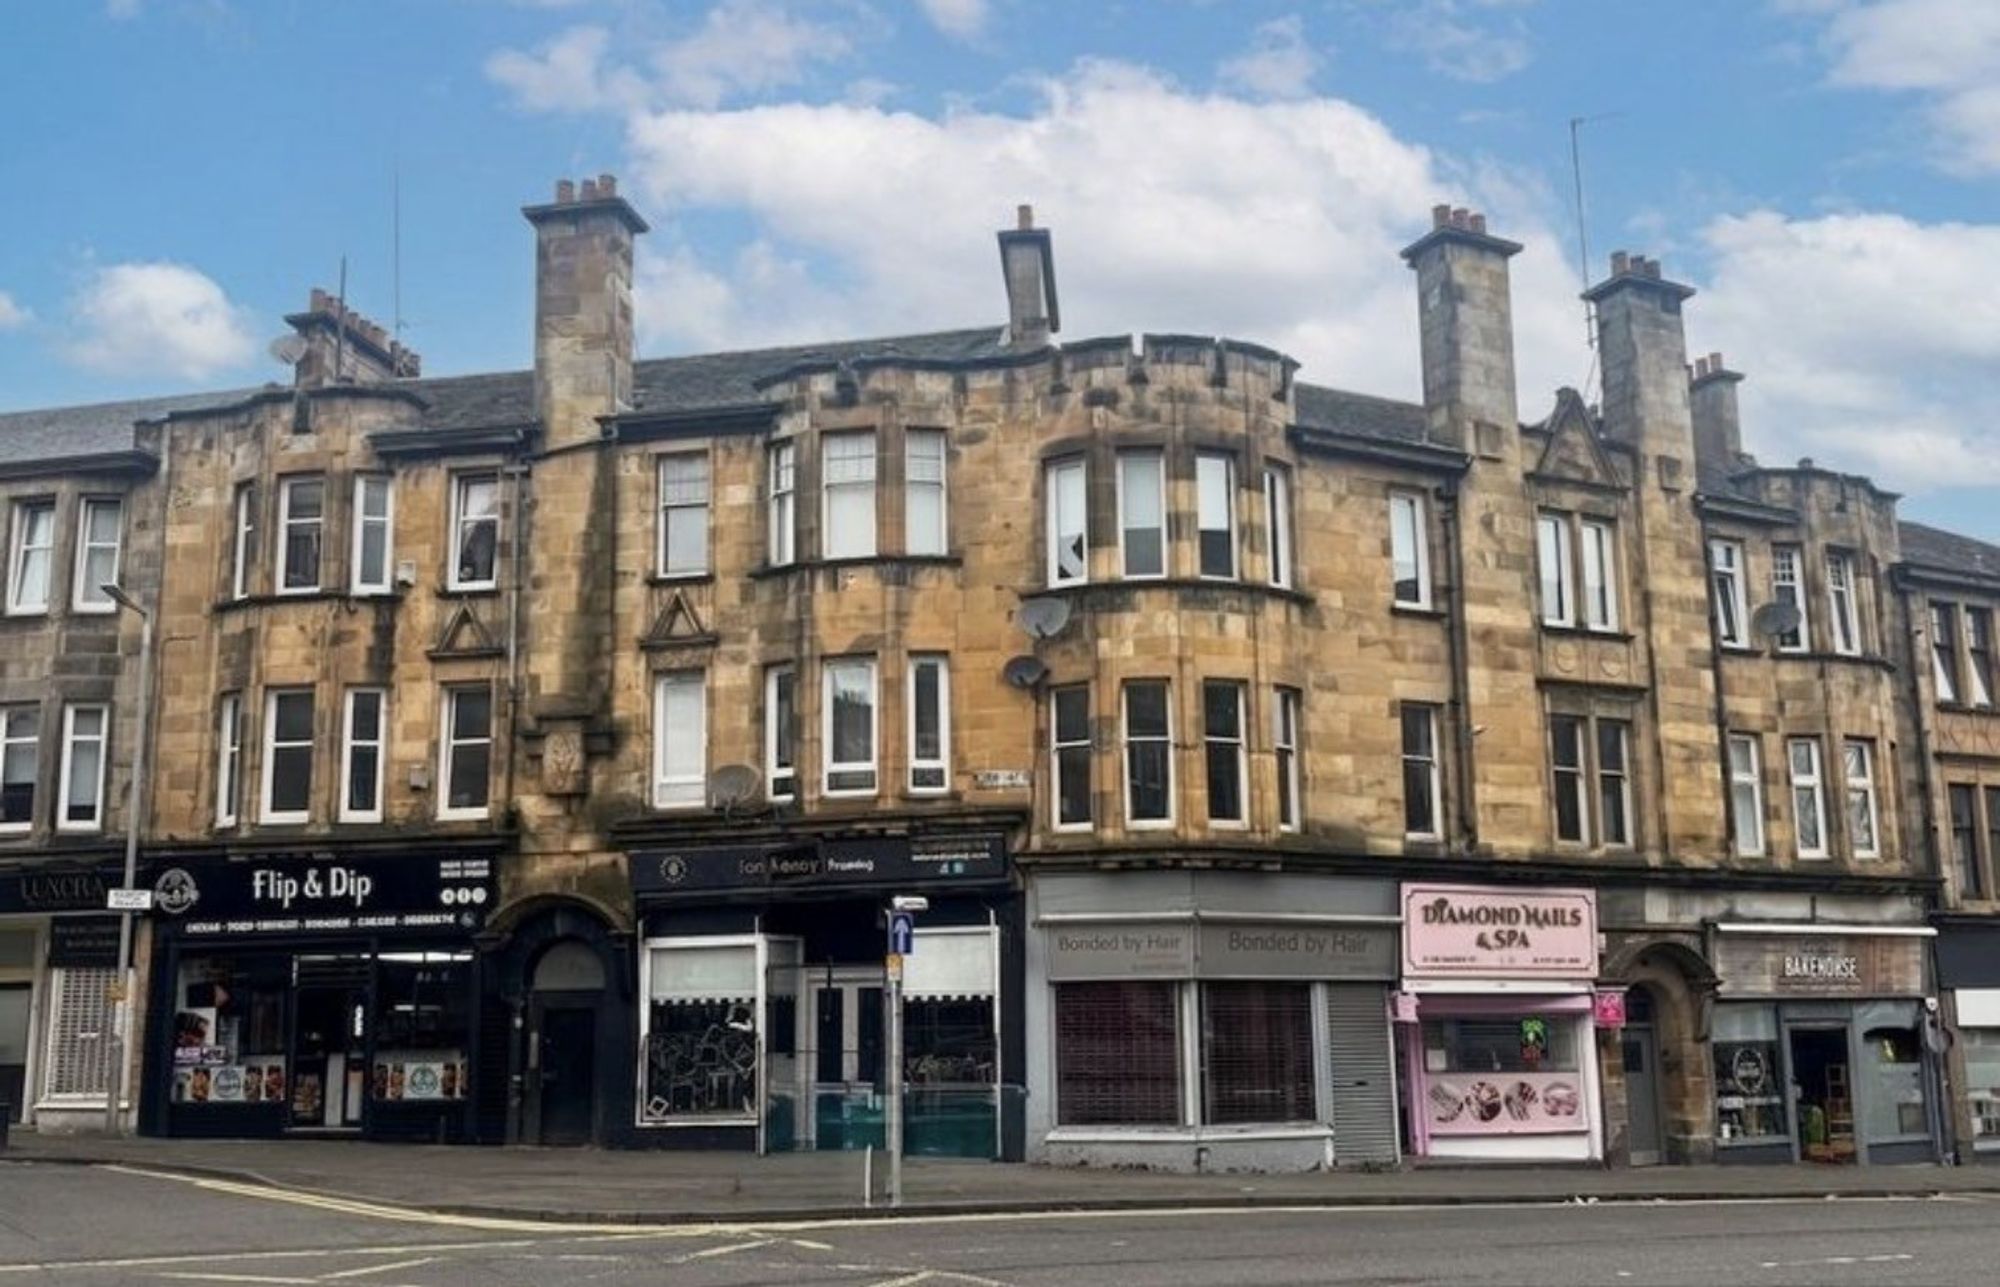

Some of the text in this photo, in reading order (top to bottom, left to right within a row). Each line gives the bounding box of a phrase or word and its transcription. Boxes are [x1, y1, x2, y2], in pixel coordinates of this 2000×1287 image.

[253, 866, 373, 909] Flip & Dip
[1421, 899, 1582, 929] DIAMOND NAILS
[1057, 934, 1181, 953] Bonded by Hair
[1227, 931, 1369, 954] Bonded by Hair
[1475, 930, 1531, 950] & SPA
